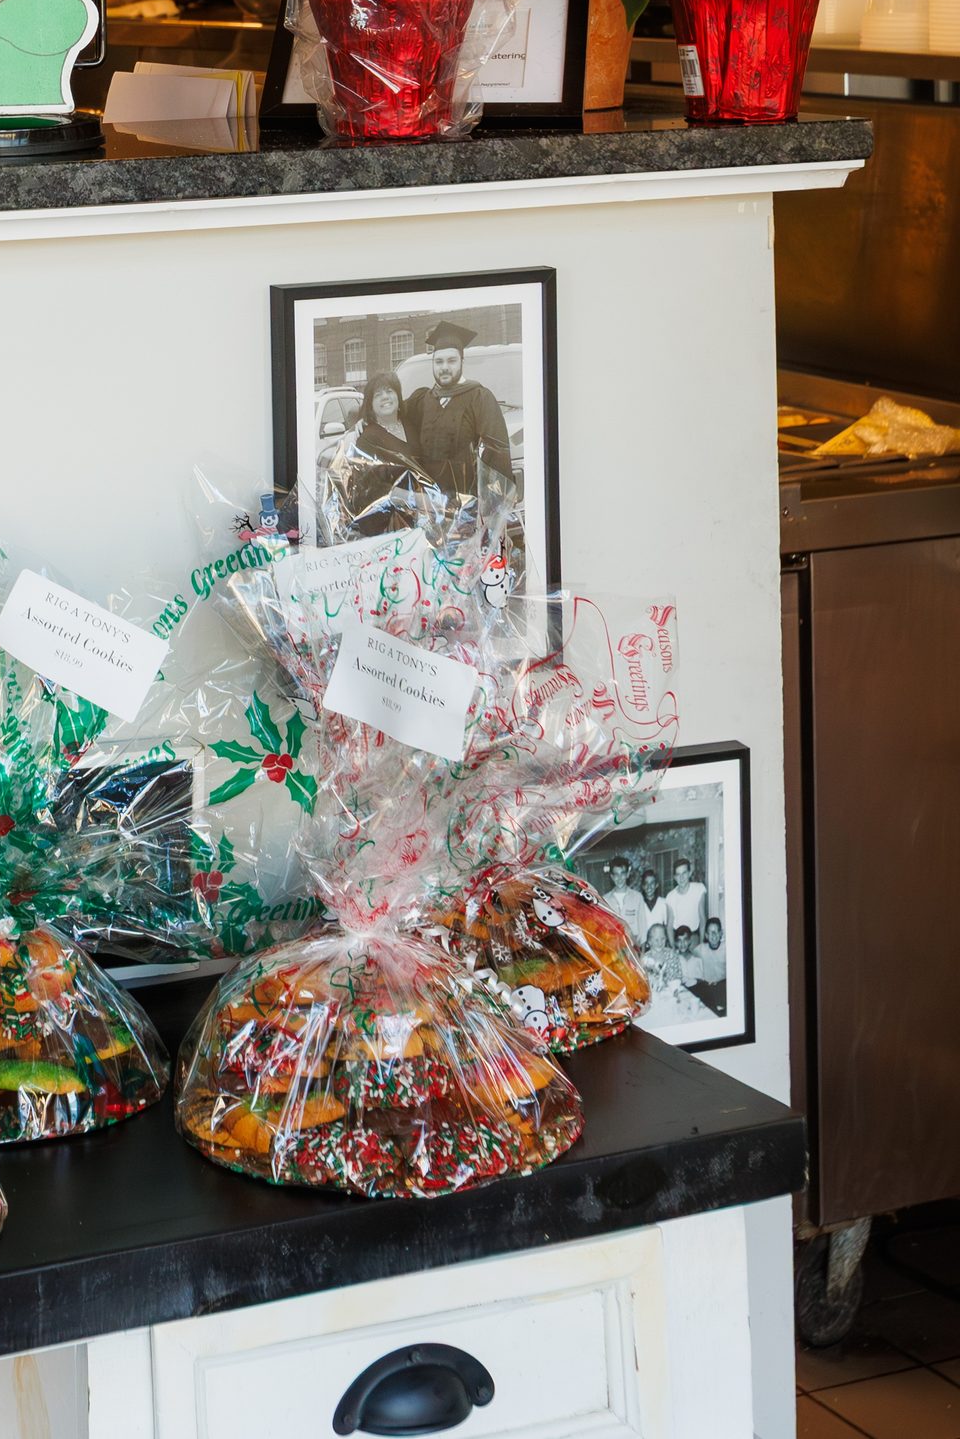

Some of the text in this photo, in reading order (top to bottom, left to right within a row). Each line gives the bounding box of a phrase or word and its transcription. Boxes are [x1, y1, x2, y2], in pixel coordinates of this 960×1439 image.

[489, 52, 526, 61] atering
[20, 607, 134, 673] Assorted Cookies
[45, 592, 131, 644] RIG A TONY'S
[352, 656, 445, 709] Assorted Cookies
[367, 637, 438, 677] RIG A TONY'S
